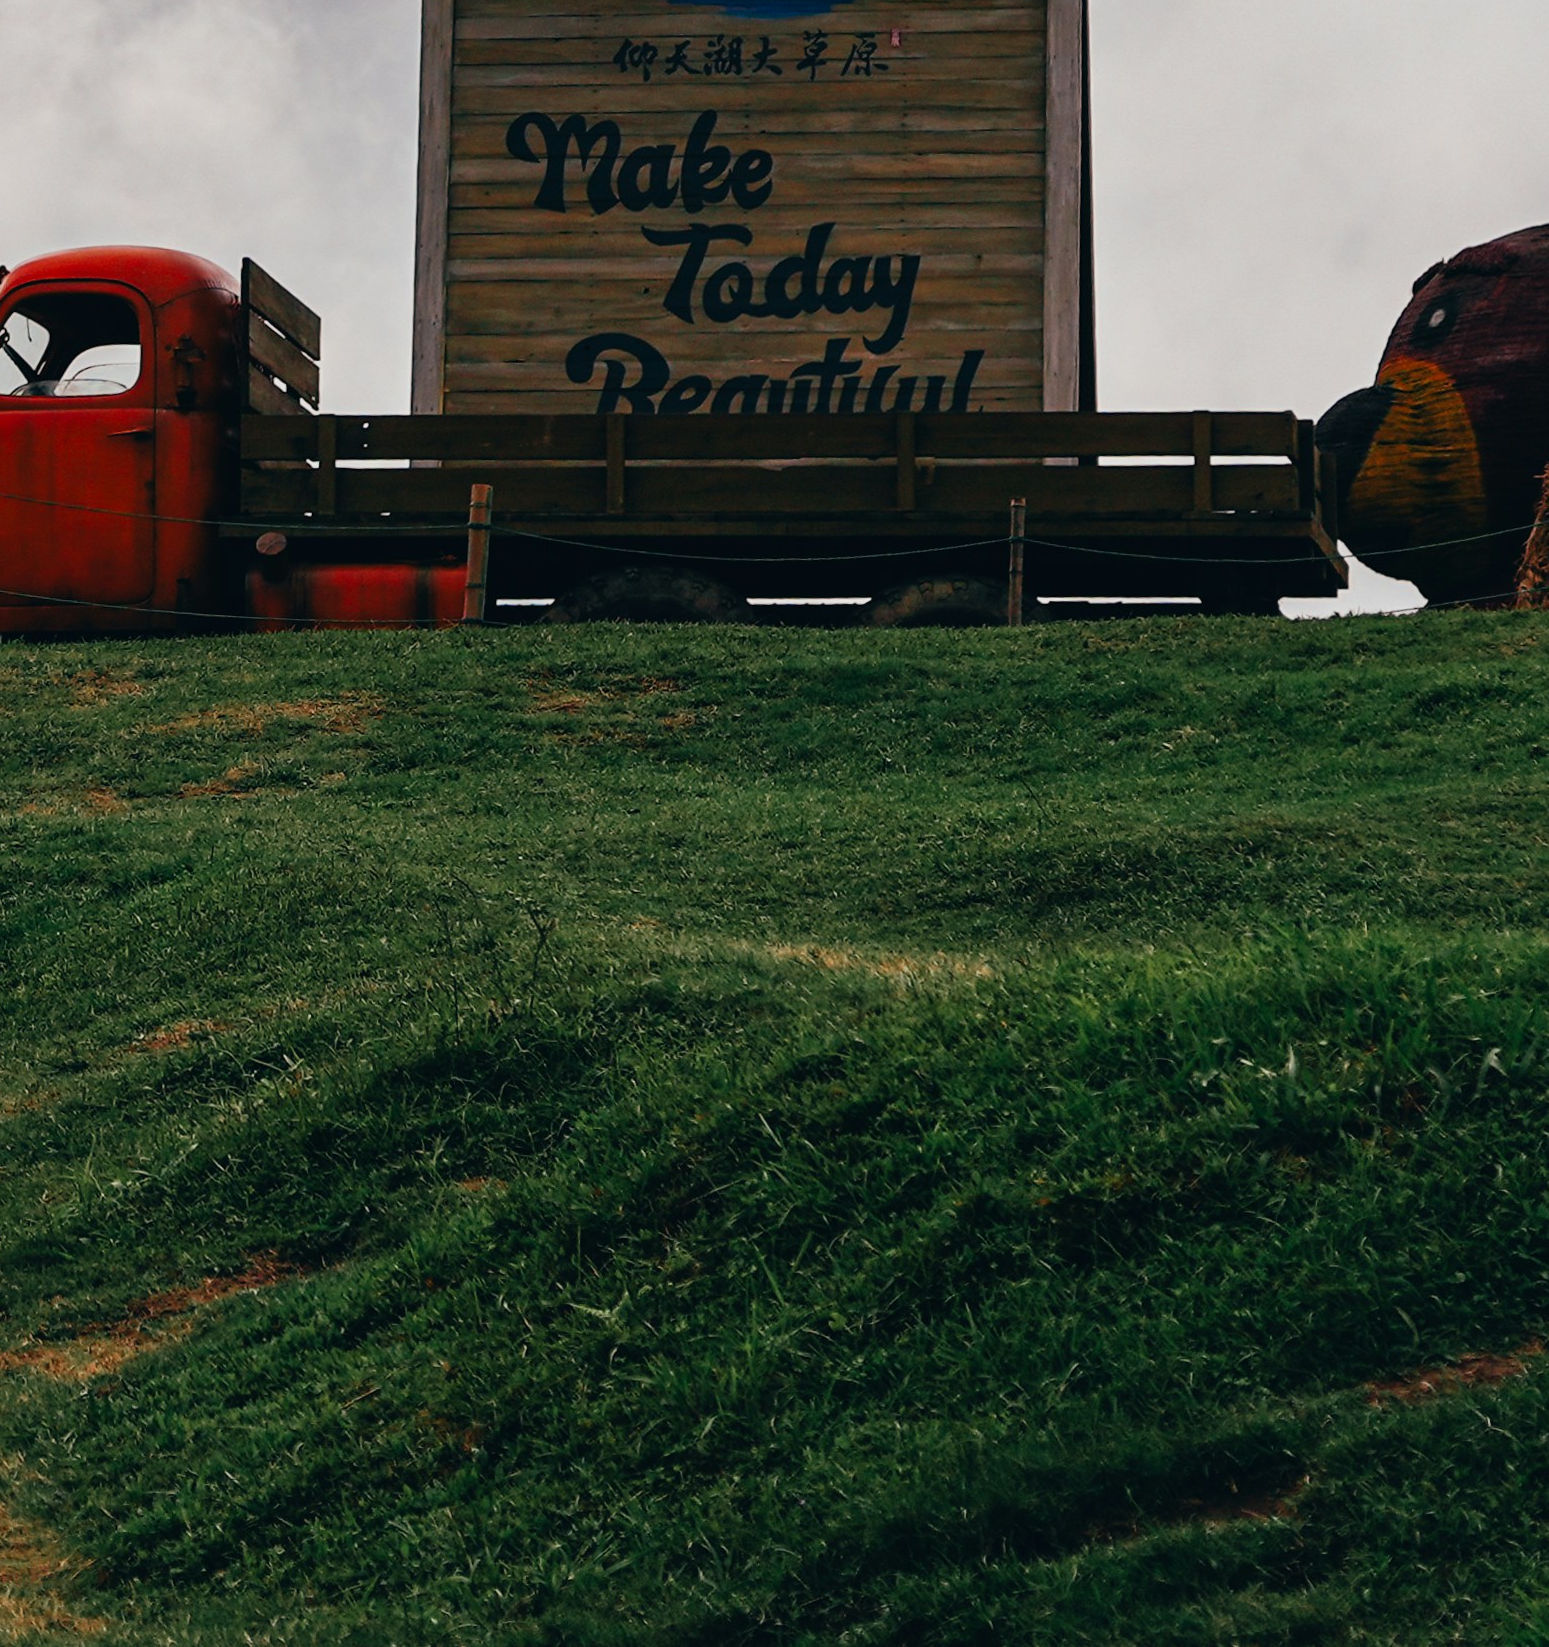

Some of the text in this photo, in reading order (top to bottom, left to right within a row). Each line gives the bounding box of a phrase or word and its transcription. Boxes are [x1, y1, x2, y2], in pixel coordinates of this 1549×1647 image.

[612, 29, 889, 82] 仰天湖大草原
[505, 109, 773, 215] Make
[640, 221, 921, 354] Today
